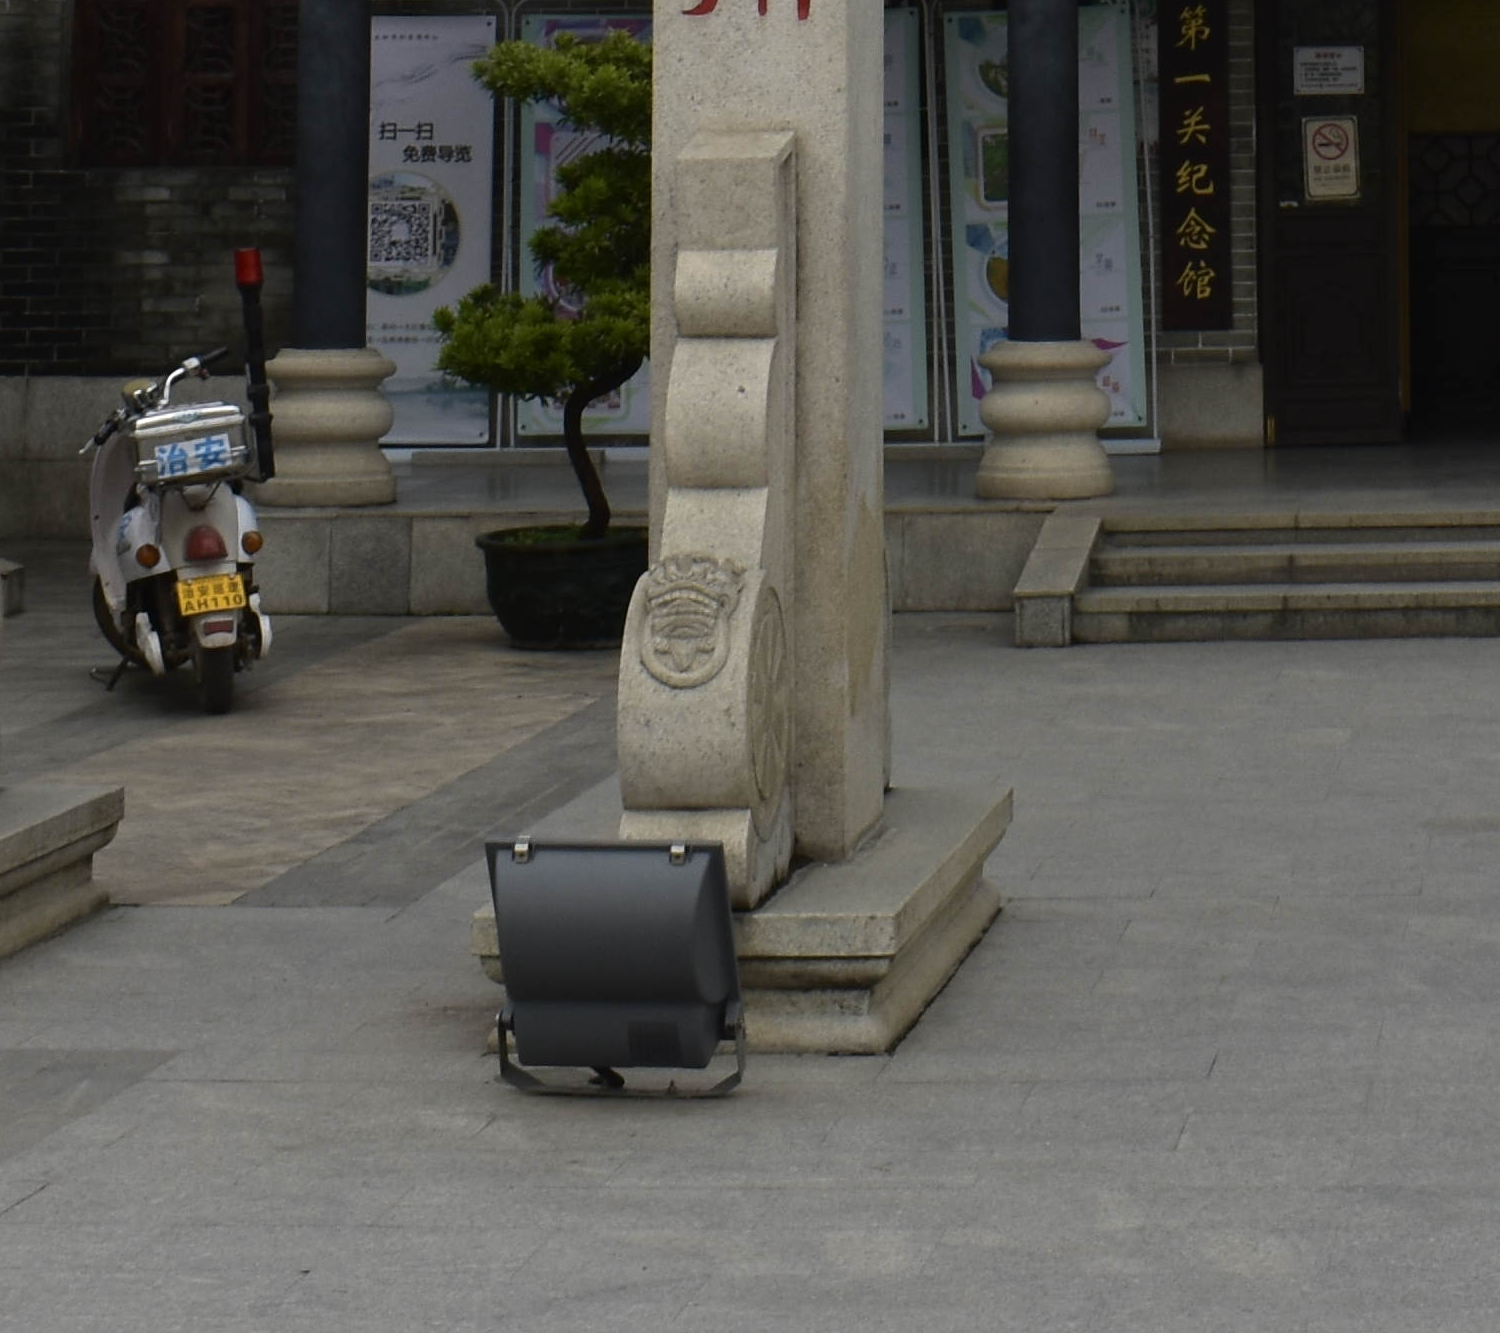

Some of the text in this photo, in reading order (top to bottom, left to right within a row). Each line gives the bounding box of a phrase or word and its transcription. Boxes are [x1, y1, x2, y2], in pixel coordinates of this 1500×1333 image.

[378, 120, 435, 142] 扫一扫
[402, 144, 473, 164] 免费导览
[157, 436, 228, 477] 治安
[184, 593, 243, 613] AH110
